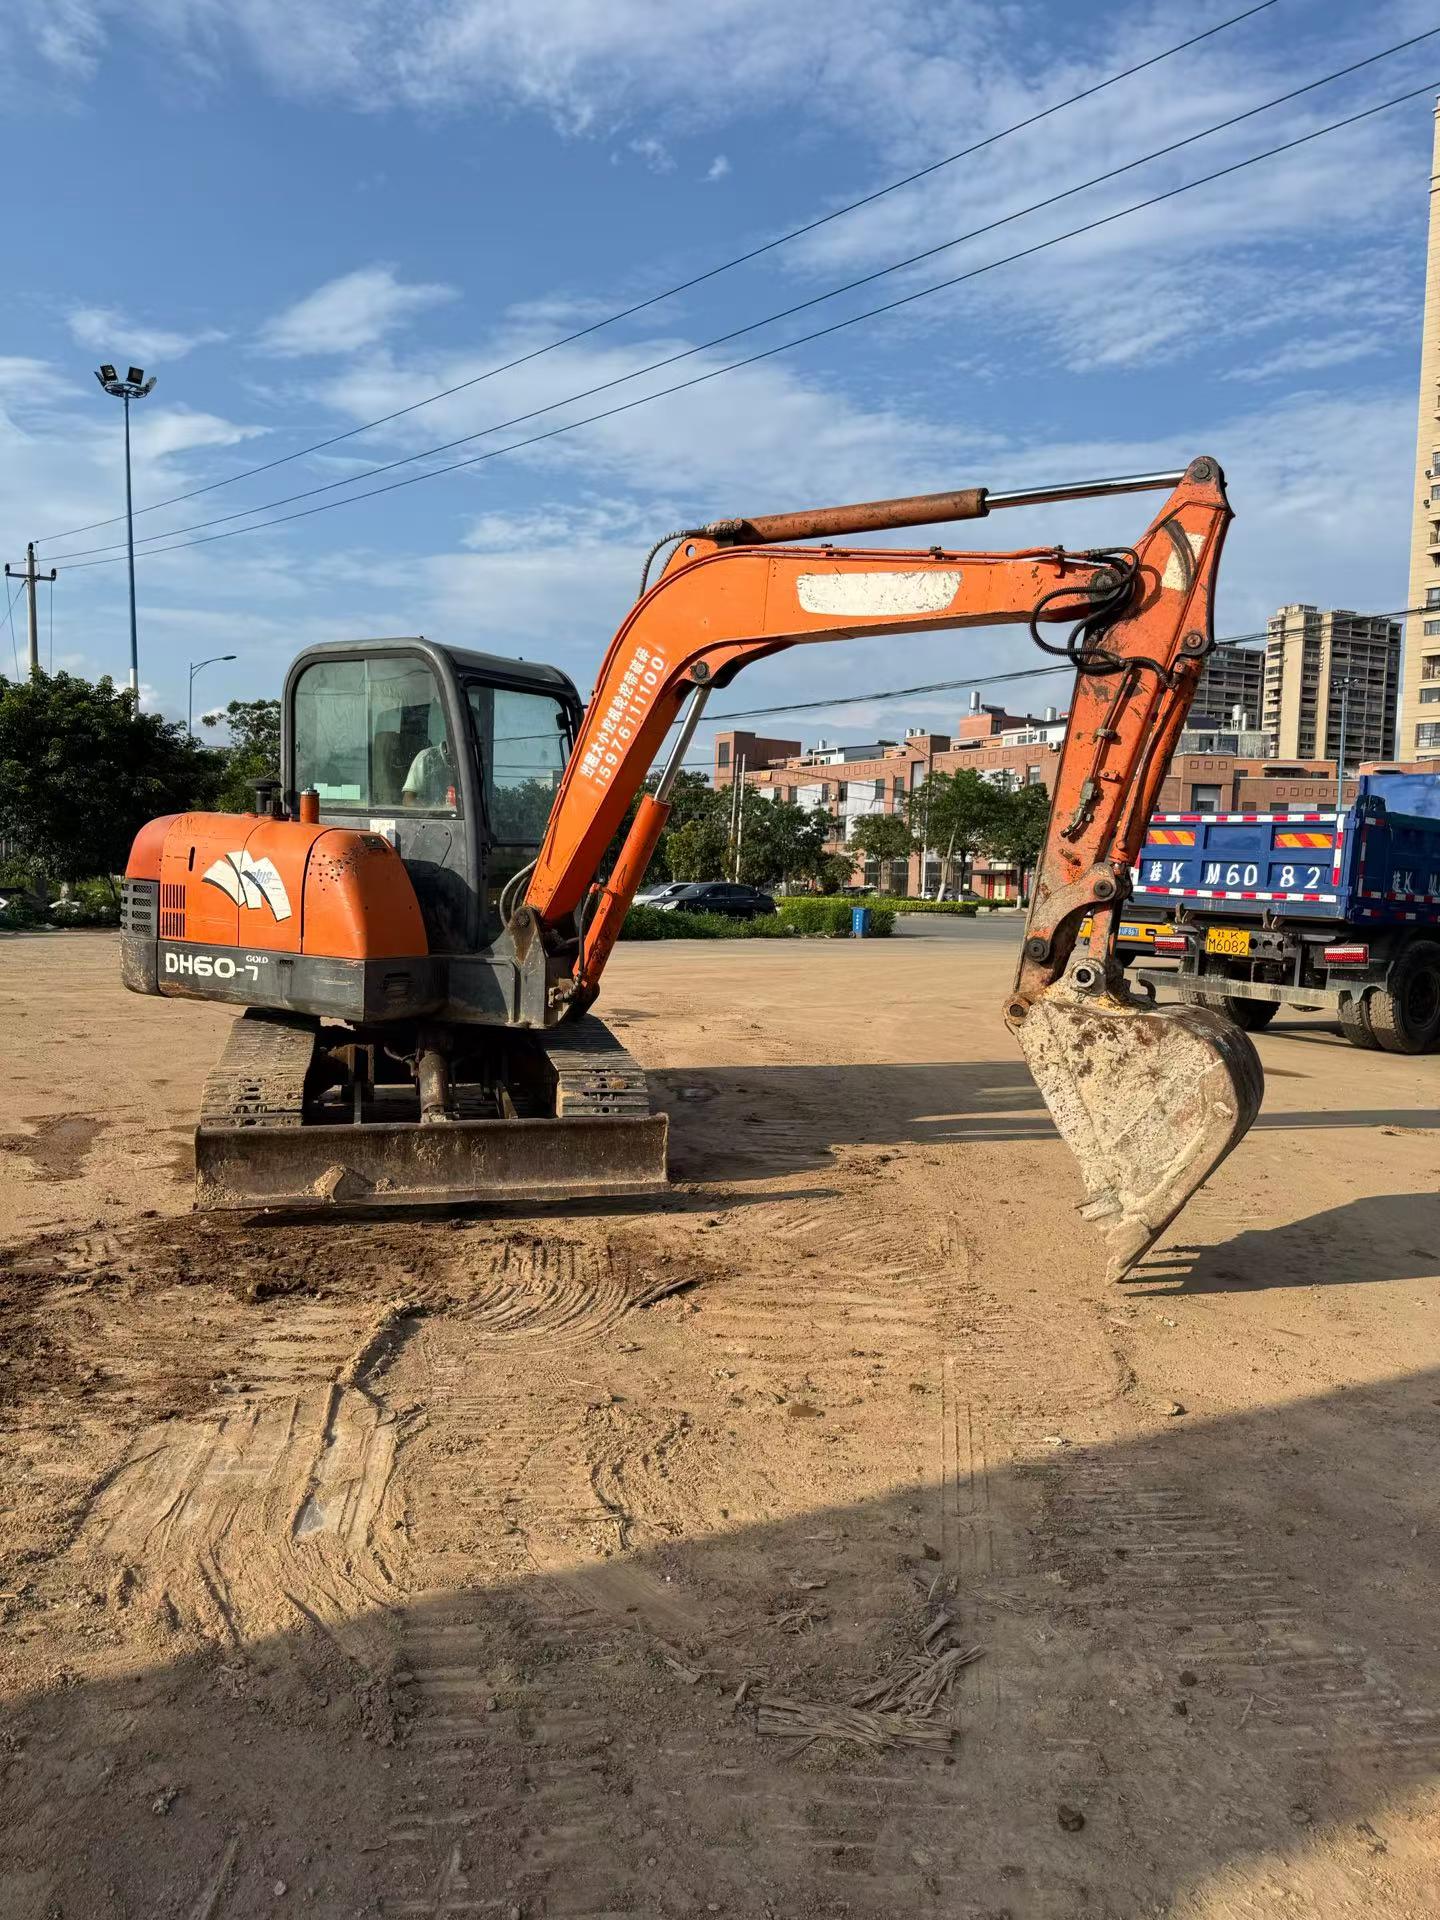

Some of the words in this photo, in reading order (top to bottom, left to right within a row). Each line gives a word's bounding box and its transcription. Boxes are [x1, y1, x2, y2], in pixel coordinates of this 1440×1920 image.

[594, 656, 664, 787] 15976111100
[1208, 938, 1247, 954] M6082
[165, 952, 259, 981] DH60-7
[245, 954, 269, 964] GOLD
